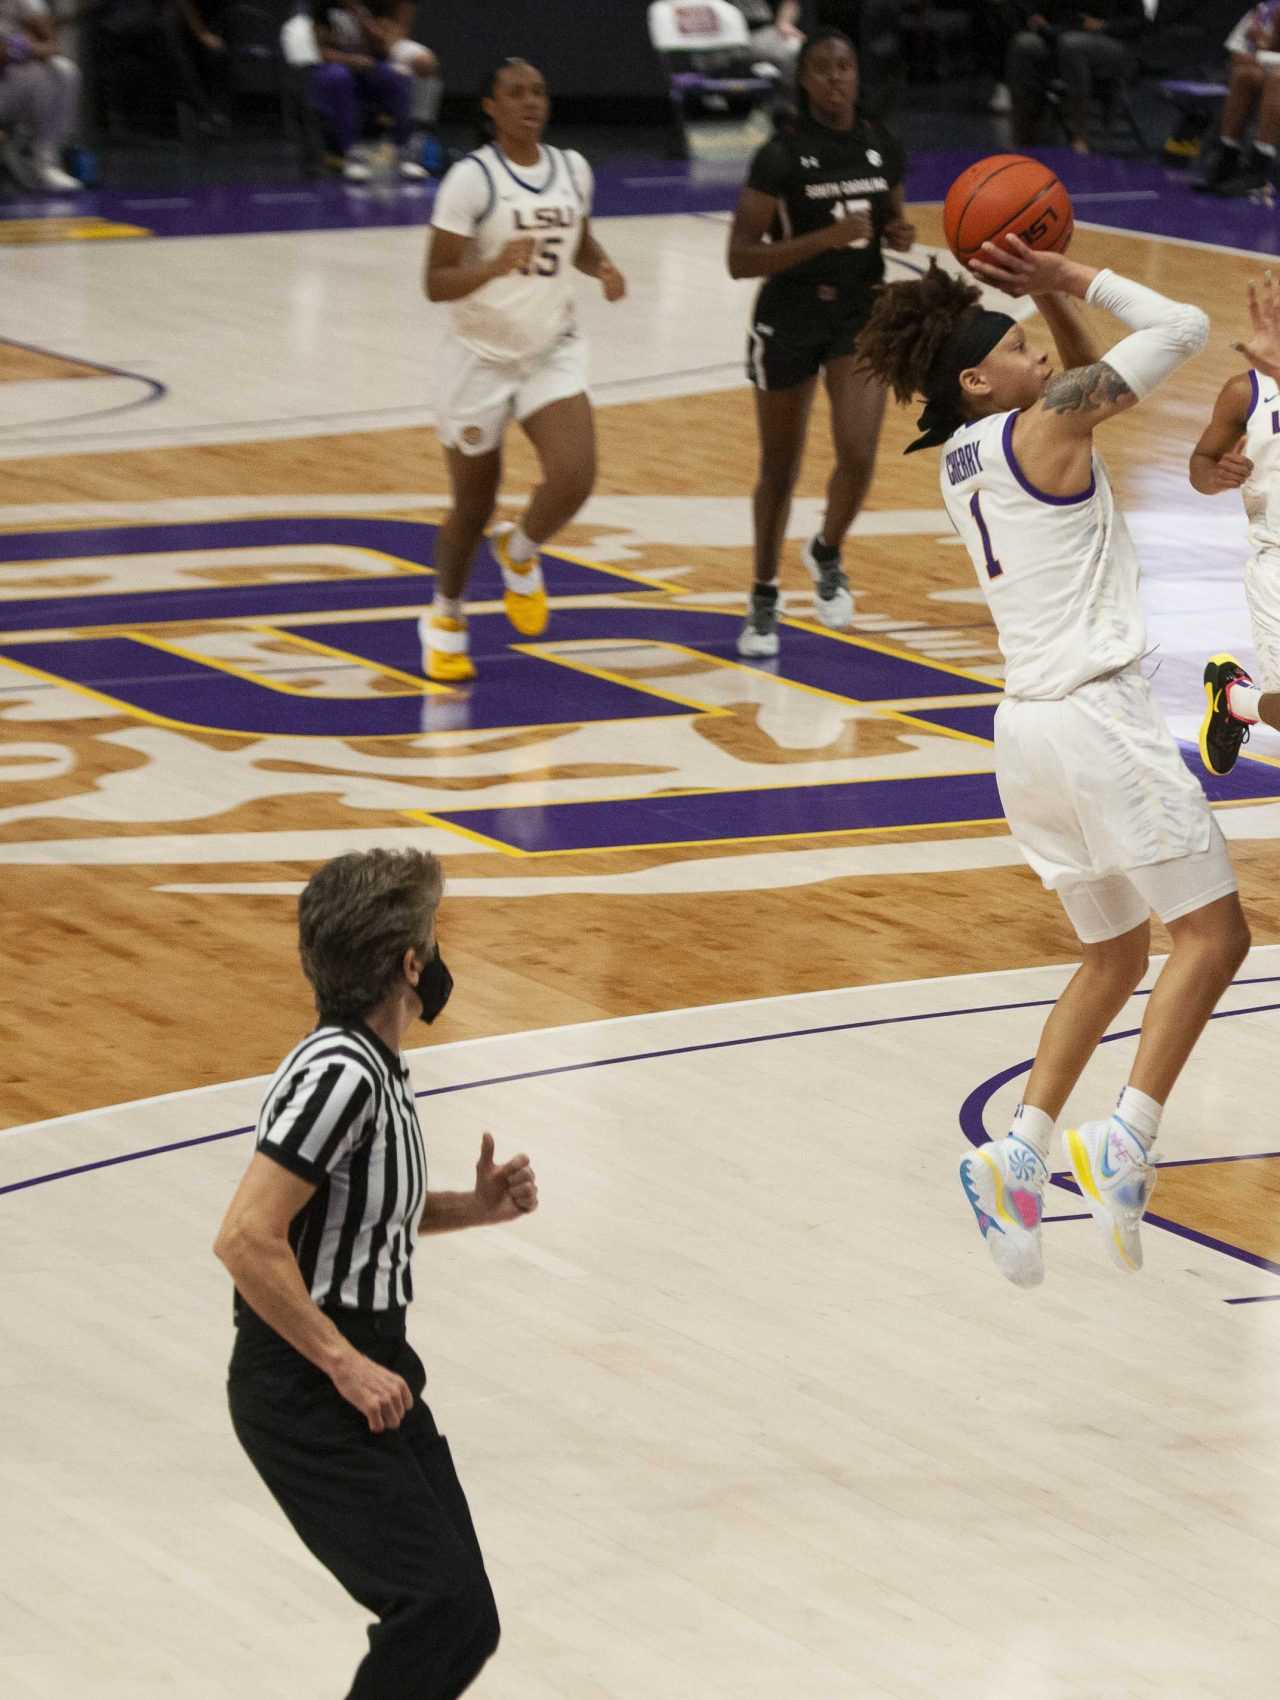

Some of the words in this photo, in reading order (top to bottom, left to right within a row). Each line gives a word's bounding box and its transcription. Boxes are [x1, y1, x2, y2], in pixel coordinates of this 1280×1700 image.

[513, 206, 575, 230] LSU
[945, 440, 984, 486] CHERRY
[969, 490, 1004, 580] 1
